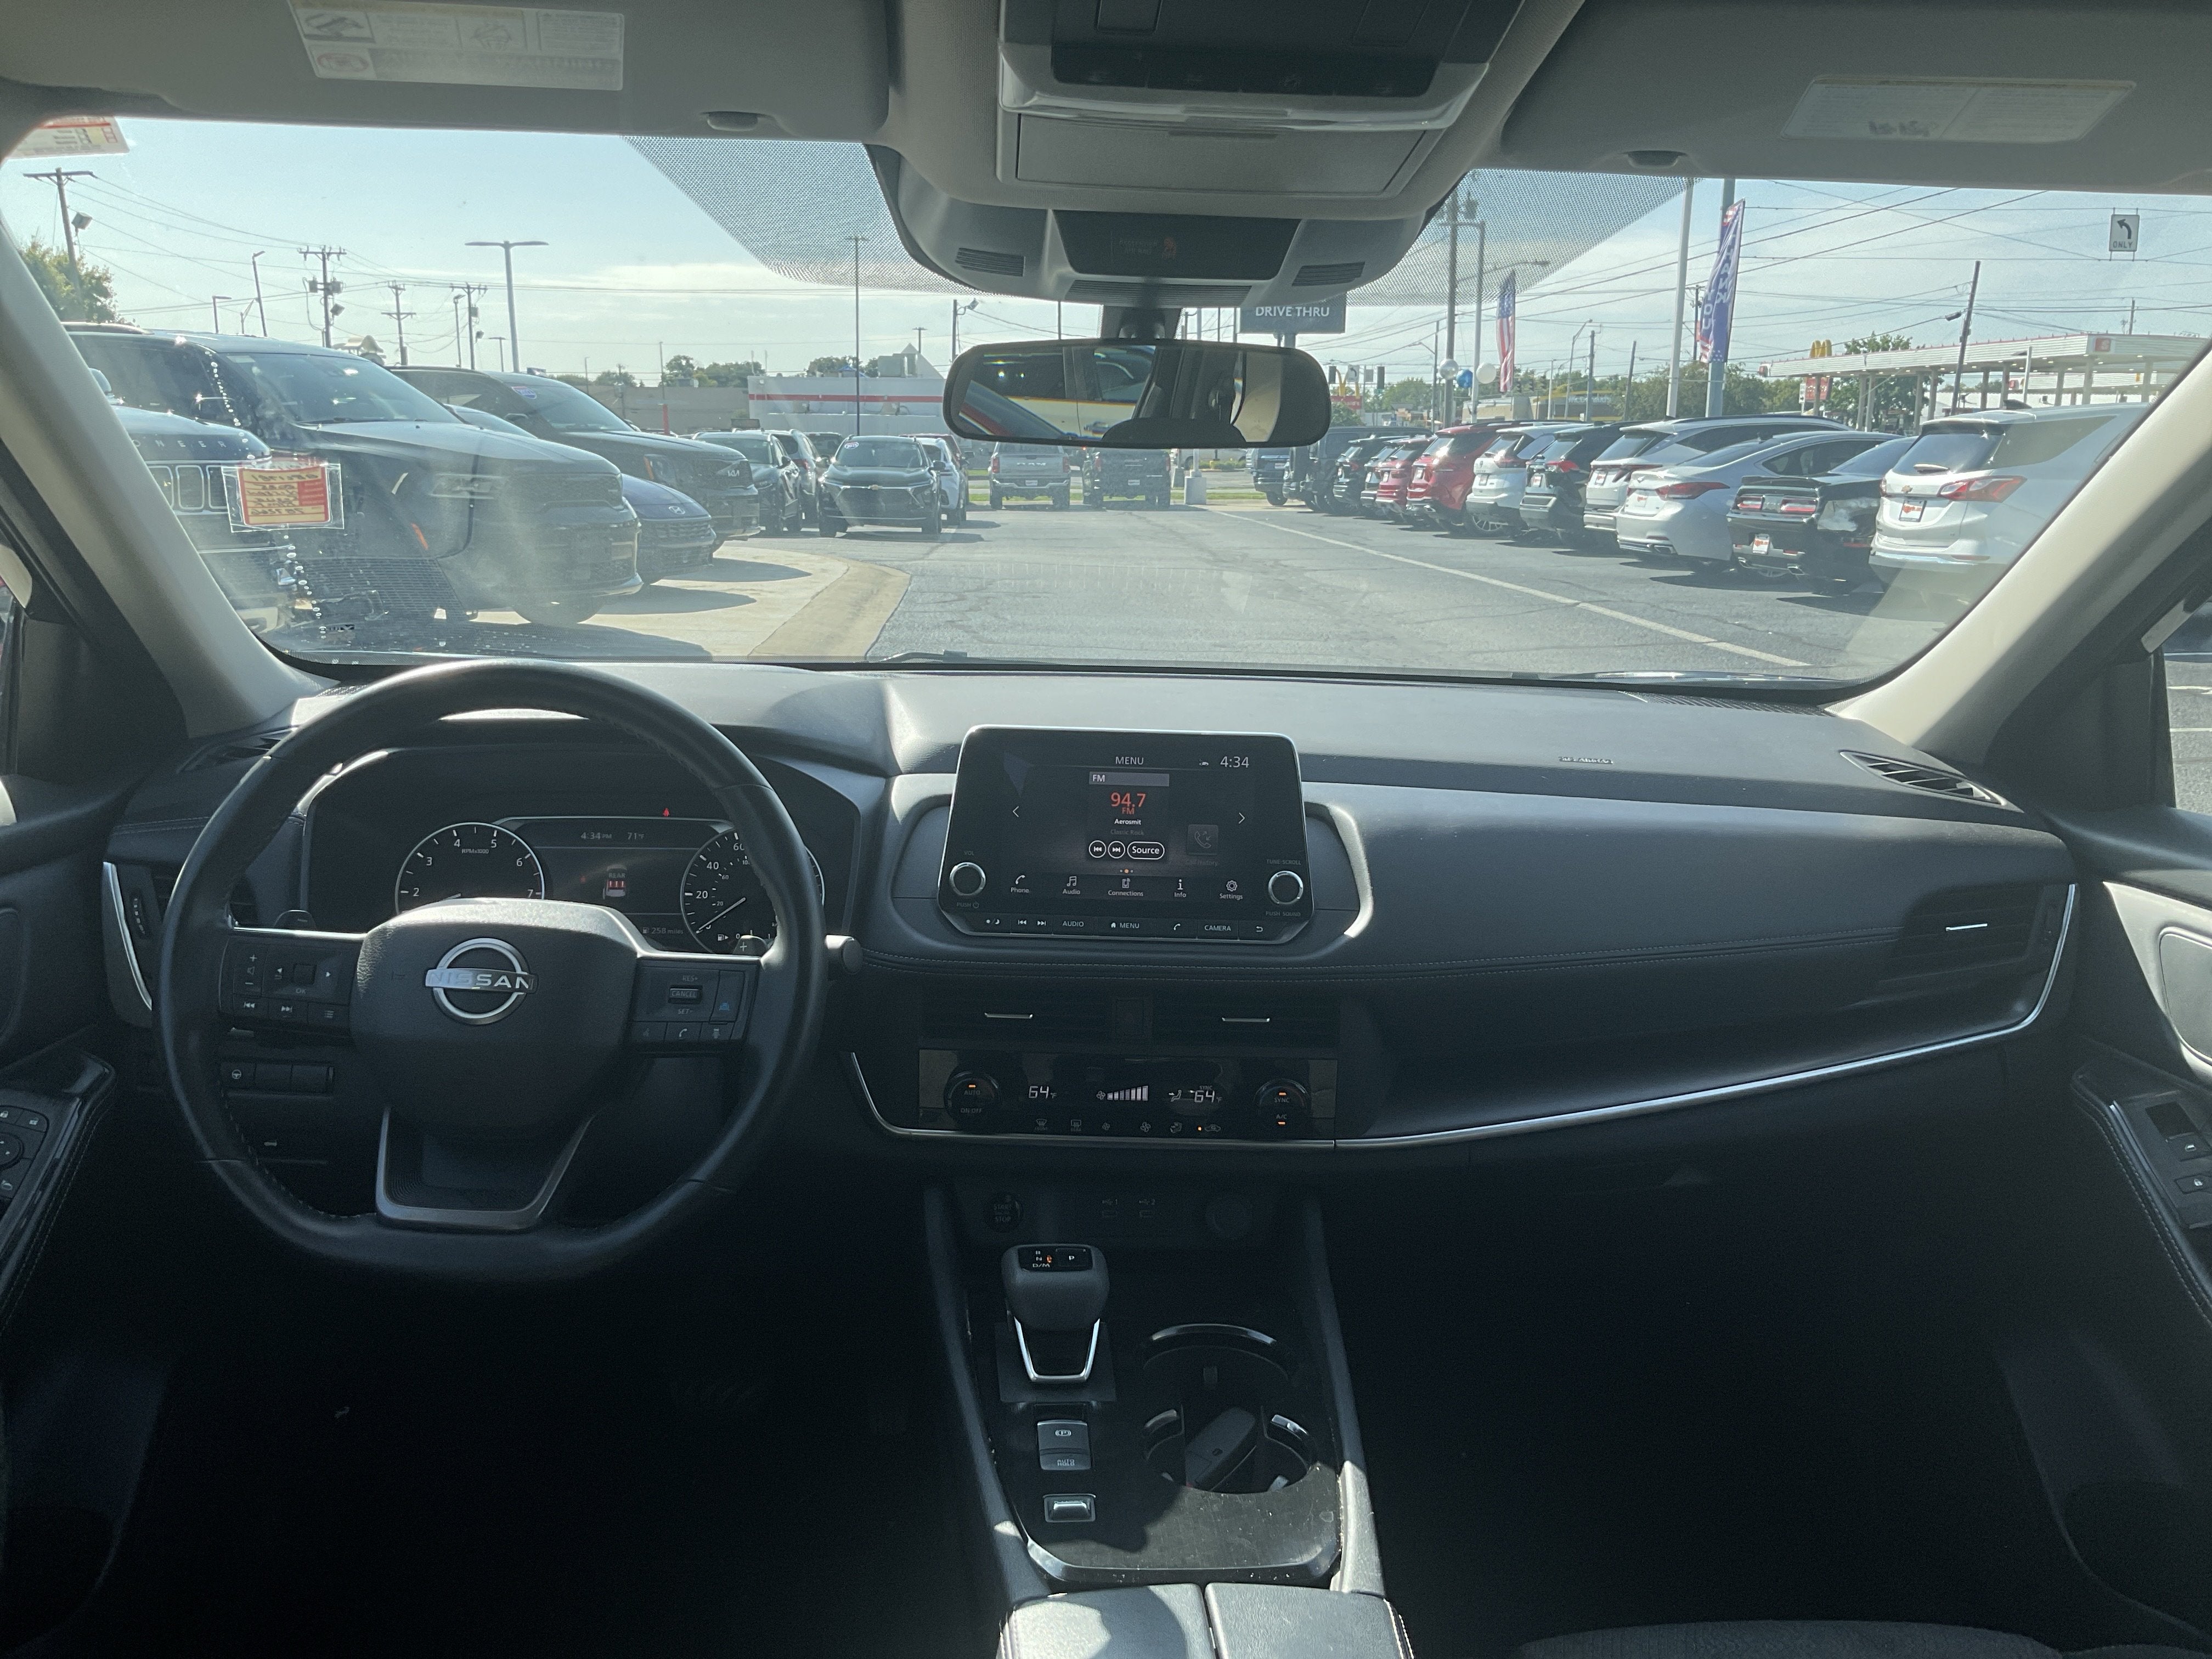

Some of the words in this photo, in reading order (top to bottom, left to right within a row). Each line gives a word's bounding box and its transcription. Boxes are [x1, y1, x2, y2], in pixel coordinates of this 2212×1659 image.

[1255, 306, 1293, 317] DRIVE
[1295, 306, 1330, 317] THRU
[1702, 289, 1716, 330] YOU
[1115, 756, 1144, 765] MENU
[1220, 756, 1249, 768] 4:34
[1092, 774, 1105, 782] FM
[1110, 792, 1146, 808] 94.7
[580, 832, 601, 840] 4:34
[454, 839, 461, 847] 4
[491, 839, 497, 848] 5
[1132, 846, 1160, 854] Source
[426, 857, 432, 866] 3
[516, 858, 523, 867] 6
[706, 861, 719, 870] 40
[413, 888, 420, 896] 2
[527, 889, 534, 898] 7
[696, 890, 708, 899] 20
[428, 971, 534, 991] NISSAN
[671, 990, 697, 998] CANCEL
